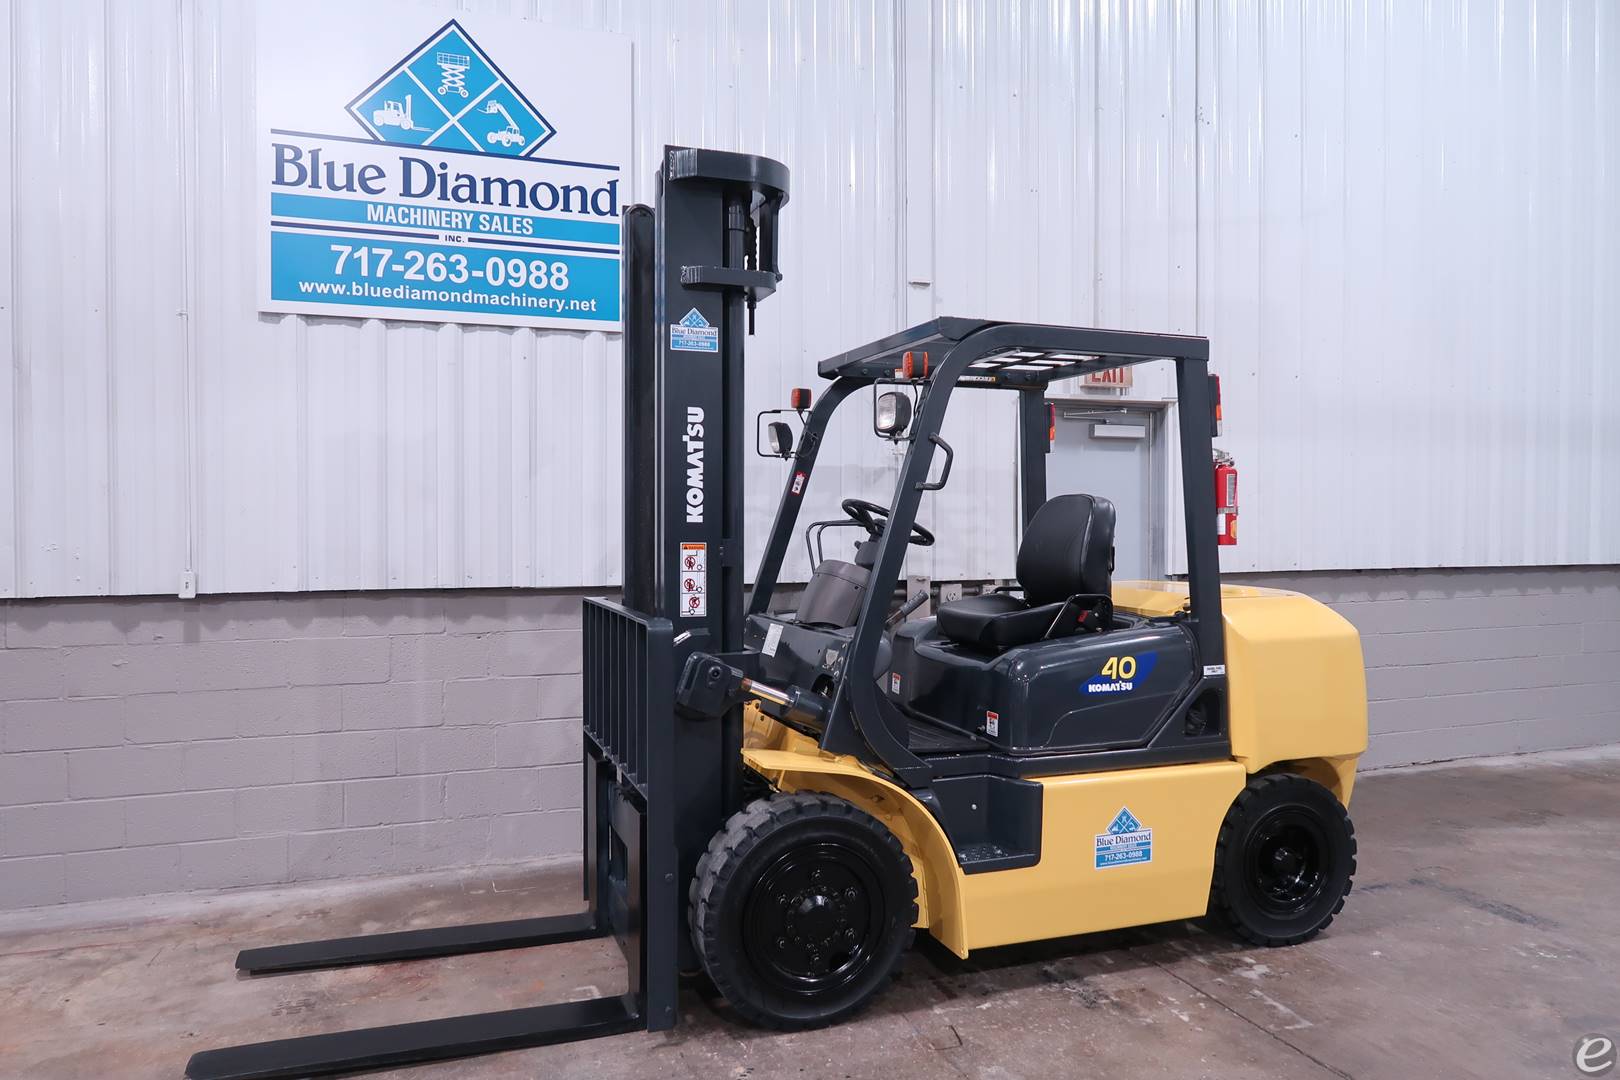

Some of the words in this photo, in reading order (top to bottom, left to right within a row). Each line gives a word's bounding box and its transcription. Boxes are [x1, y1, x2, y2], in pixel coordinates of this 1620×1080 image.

[272, 143, 386, 195] Blue
[399, 156, 619, 217] Diamond
[367, 203, 474, 231] MACHINERY
[479, 213, 534, 235] SALES
[444, 234, 465, 243] INC.
[330, 244, 569, 291] 717-263-0988
[299, 281, 597, 312] www.bluediamondmachinery.net
[683, 406, 705, 523] KOMATSU
[1101, 656, 1136, 680] 40
[1088, 681, 1133, 692] KOMATSU
[1096, 838, 1114, 846] Blue
[1115, 832, 1151, 844] Diamond
